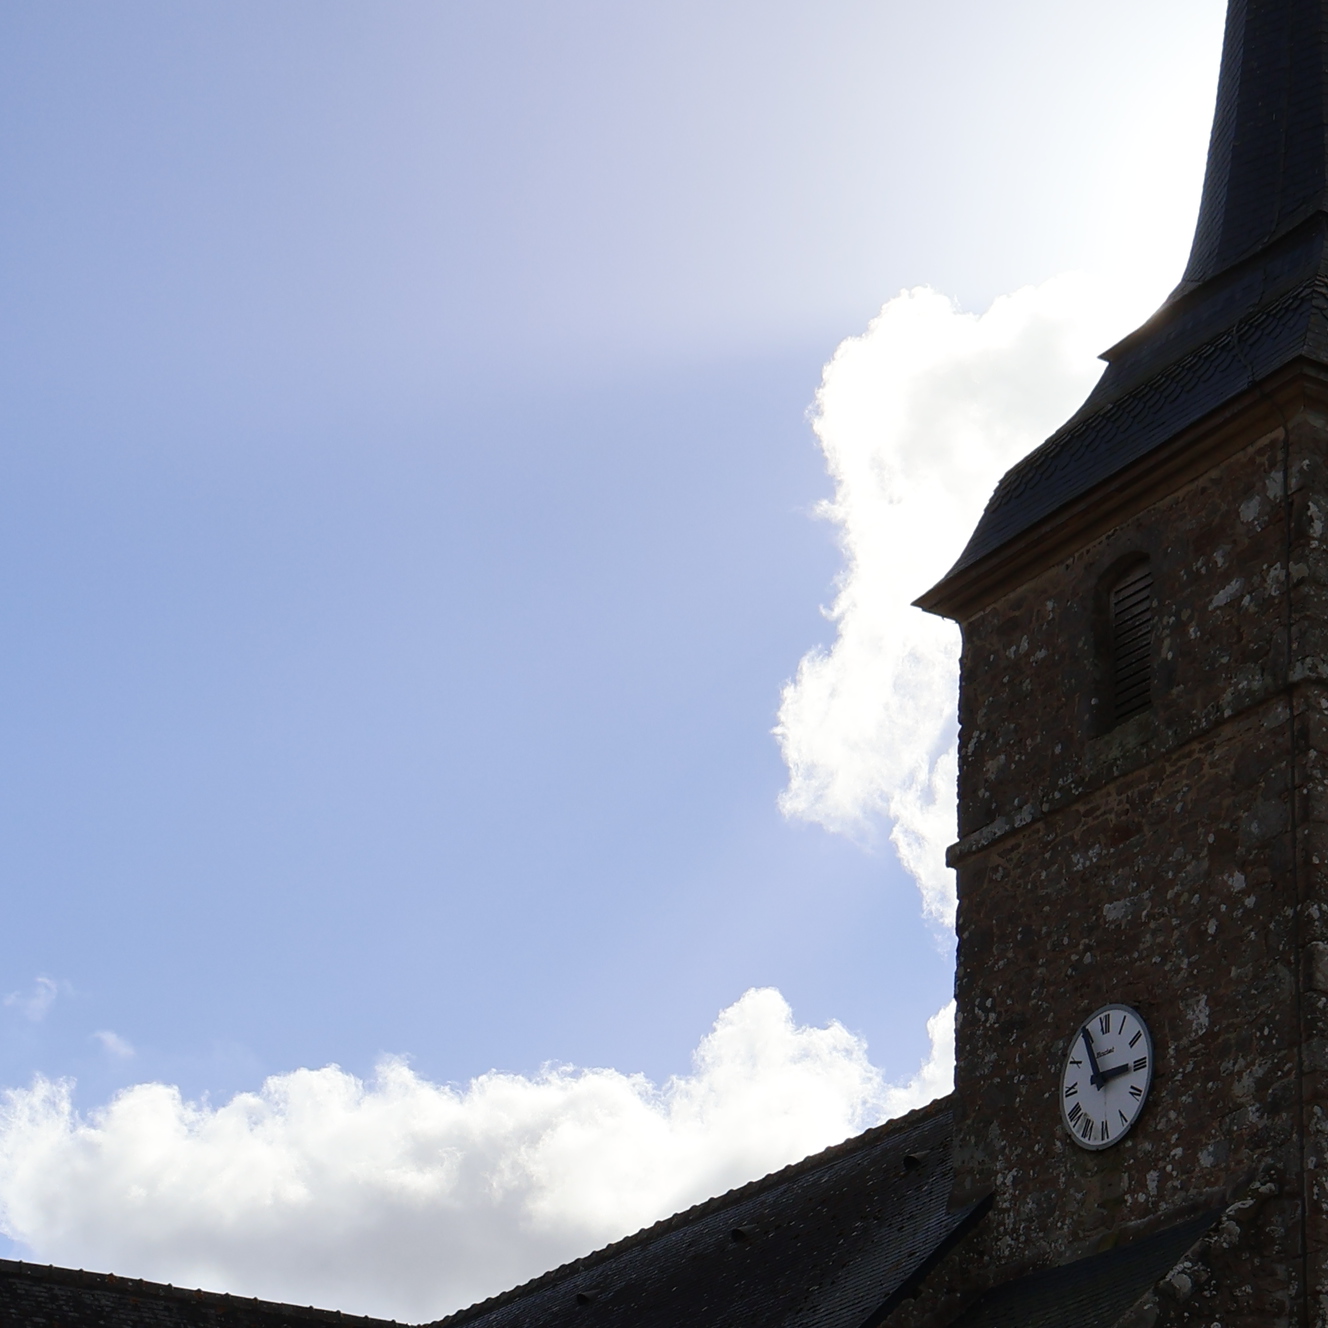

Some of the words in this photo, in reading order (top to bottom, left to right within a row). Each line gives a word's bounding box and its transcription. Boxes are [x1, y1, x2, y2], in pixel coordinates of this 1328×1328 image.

[1118, 1015, 1126, 1035] I
[1128, 1030, 1142, 1048] II
[1069, 1056, 1082, 1069] X
[1133, 1056, 1147, 1072] III
[1065, 1081, 1078, 1098] IX
[1129, 1085, 1142, 1102] IV
[1067, 1101, 1084, 1129] VIII
[1118, 1109, 1128, 1127] V
[1081, 1118, 1094, 1141] VII
[1101, 1120, 1109, 1141] VI
